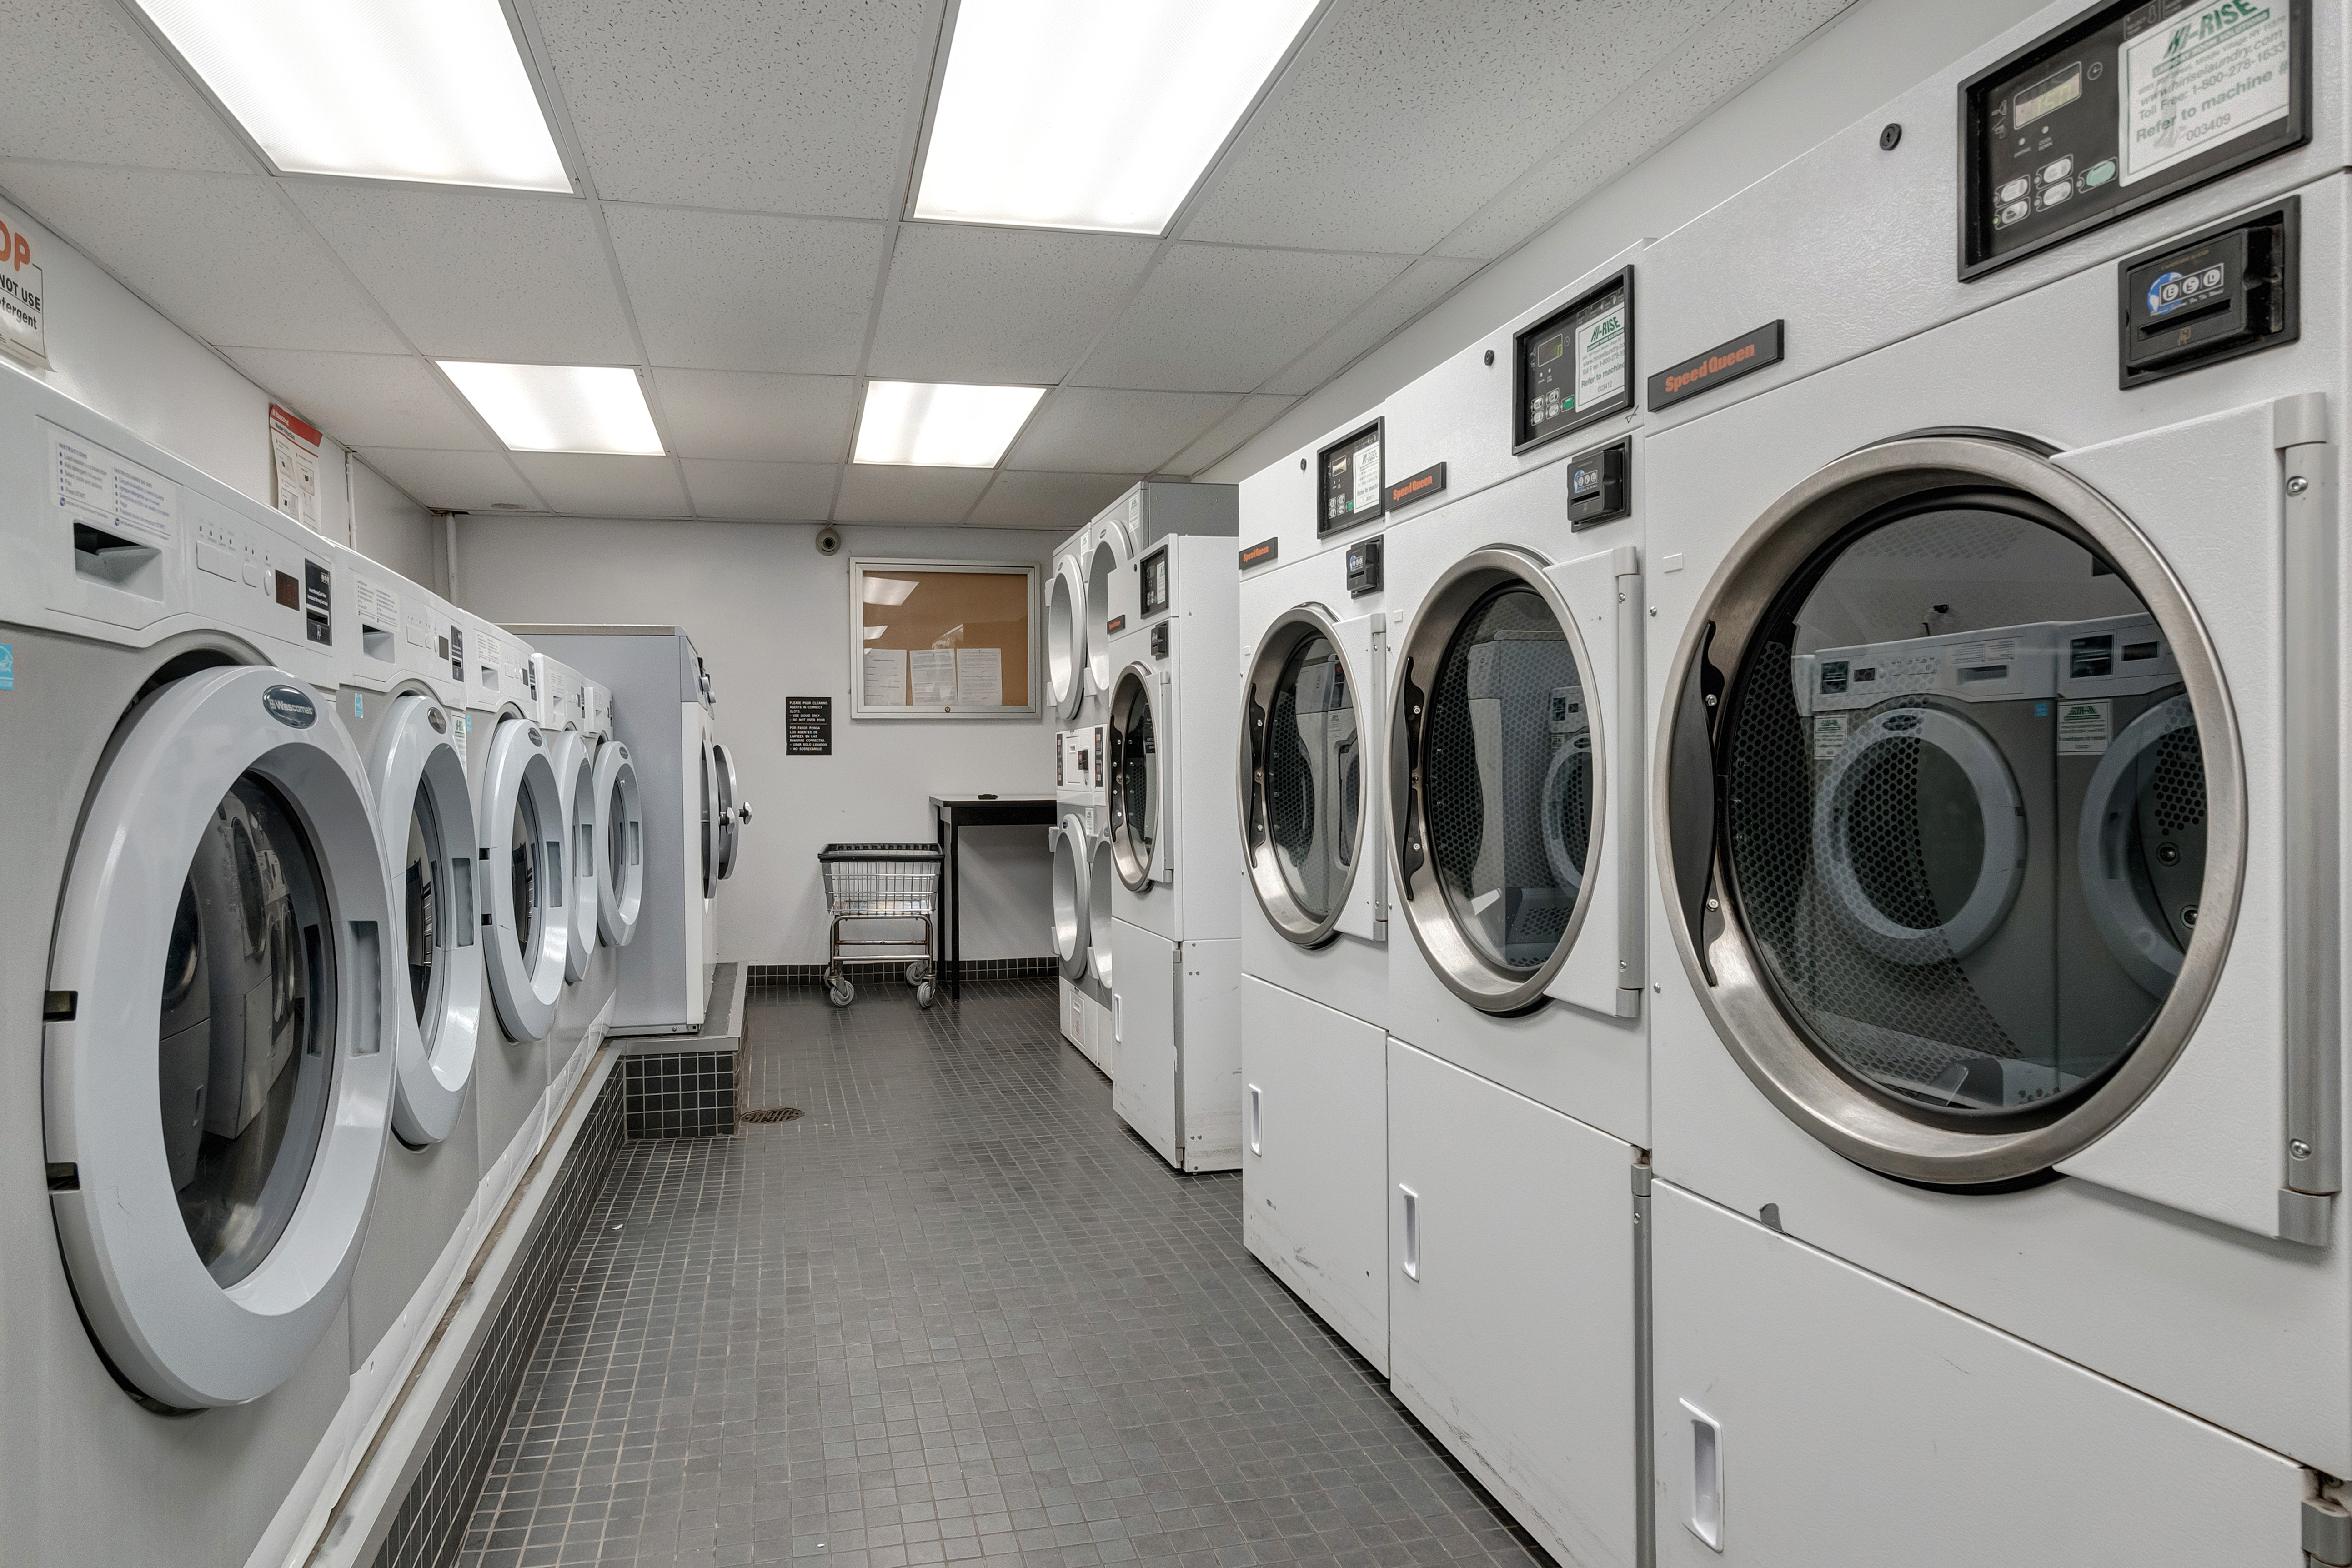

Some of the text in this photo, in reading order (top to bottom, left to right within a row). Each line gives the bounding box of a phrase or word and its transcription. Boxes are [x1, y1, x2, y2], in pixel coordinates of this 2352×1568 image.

[2163, 0, 2258, 59] HI-RISE
[2136, 112, 2176, 143] Refer
[2182, 104, 2196, 121] to
[2202, 68, 2272, 112] machine
[2139, 103, 2156, 121] Toll
[22, 287, 40, 311] USE
[0, 296, 37, 329] tergent
[1591, 316, 1620, 342] HI-RISE
[1665, 344, 1755, 392] Speed Queen
[1581, 375, 1595, 388] Refer
[59, 443, 87, 458] INSTRUCTIONS
[1393, 476, 1433, 501] Speed Queen
[1244, 546, 1269, 562] Speed Queen
[275, 700, 313, 715] Wascomat
